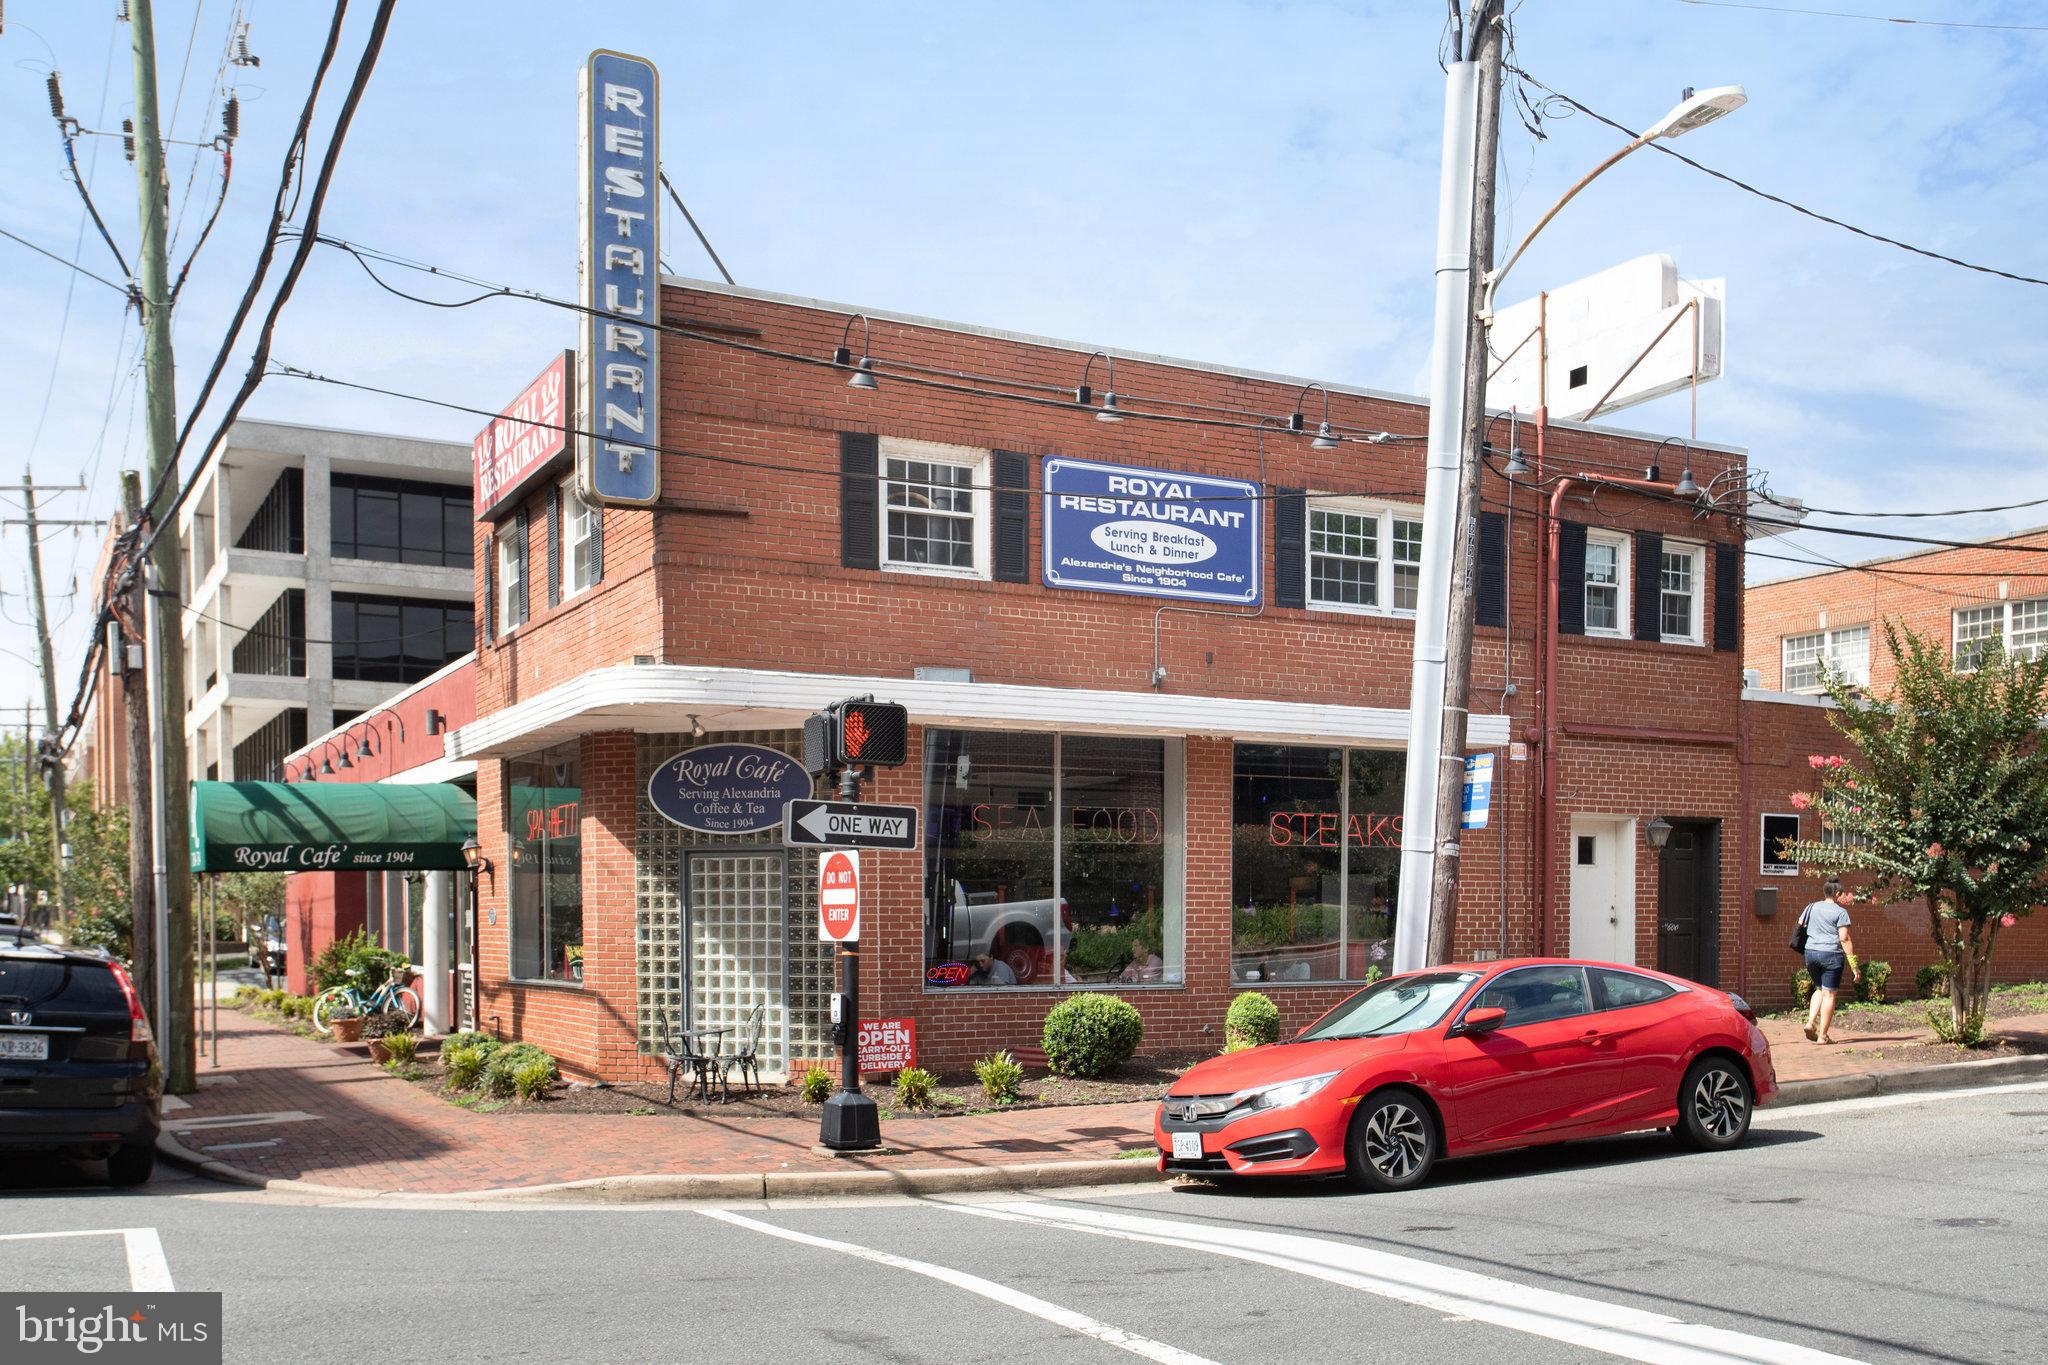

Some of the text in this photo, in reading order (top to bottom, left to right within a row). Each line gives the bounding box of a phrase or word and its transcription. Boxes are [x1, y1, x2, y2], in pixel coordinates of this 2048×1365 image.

[604, 82, 647, 474] RESTAURANT
[494, 390, 539, 457] ROYAL
[479, 408, 559, 503] RESTAURANT
[1108, 475, 1200, 503] ROYAL
[1060, 494, 1245, 528] RESTAURANT
[1104, 526, 1205, 547] Serving Breakfast
[1110, 540, 1200, 560] Lunch & Dinner
[1061, 556, 1132, 572] Alexandria's
[1136, 564, 1214, 580] Neighborhood
[1122, 573, 1188, 588] Since 1904
[673, 754, 791, 787] Royal Café
[678, 787, 781, 801] Serving Alexandria
[693, 803, 766, 814] Coffee & Tea
[704, 817, 754, 829] Since 1904
[829, 815, 902, 836] ONE WAY
[1072, 807, 1160, 844] FOOD
[1270, 812, 1405, 848] STEAKS
[234, 845, 293, 868] Royal
[353, 851, 382, 863] since
[385, 851, 414, 863] 1904
[826, 871, 852, 884] DO NOT
[828, 908, 849, 921] ENTER
[926, 966, 969, 980] OPEN
[863, 1021, 901, 1031] WE ARE
[858, 1029, 910, 1046] OPEN
[860, 1060, 906, 1070] DELIVERY
[904, 1052, 912, 1060] &
